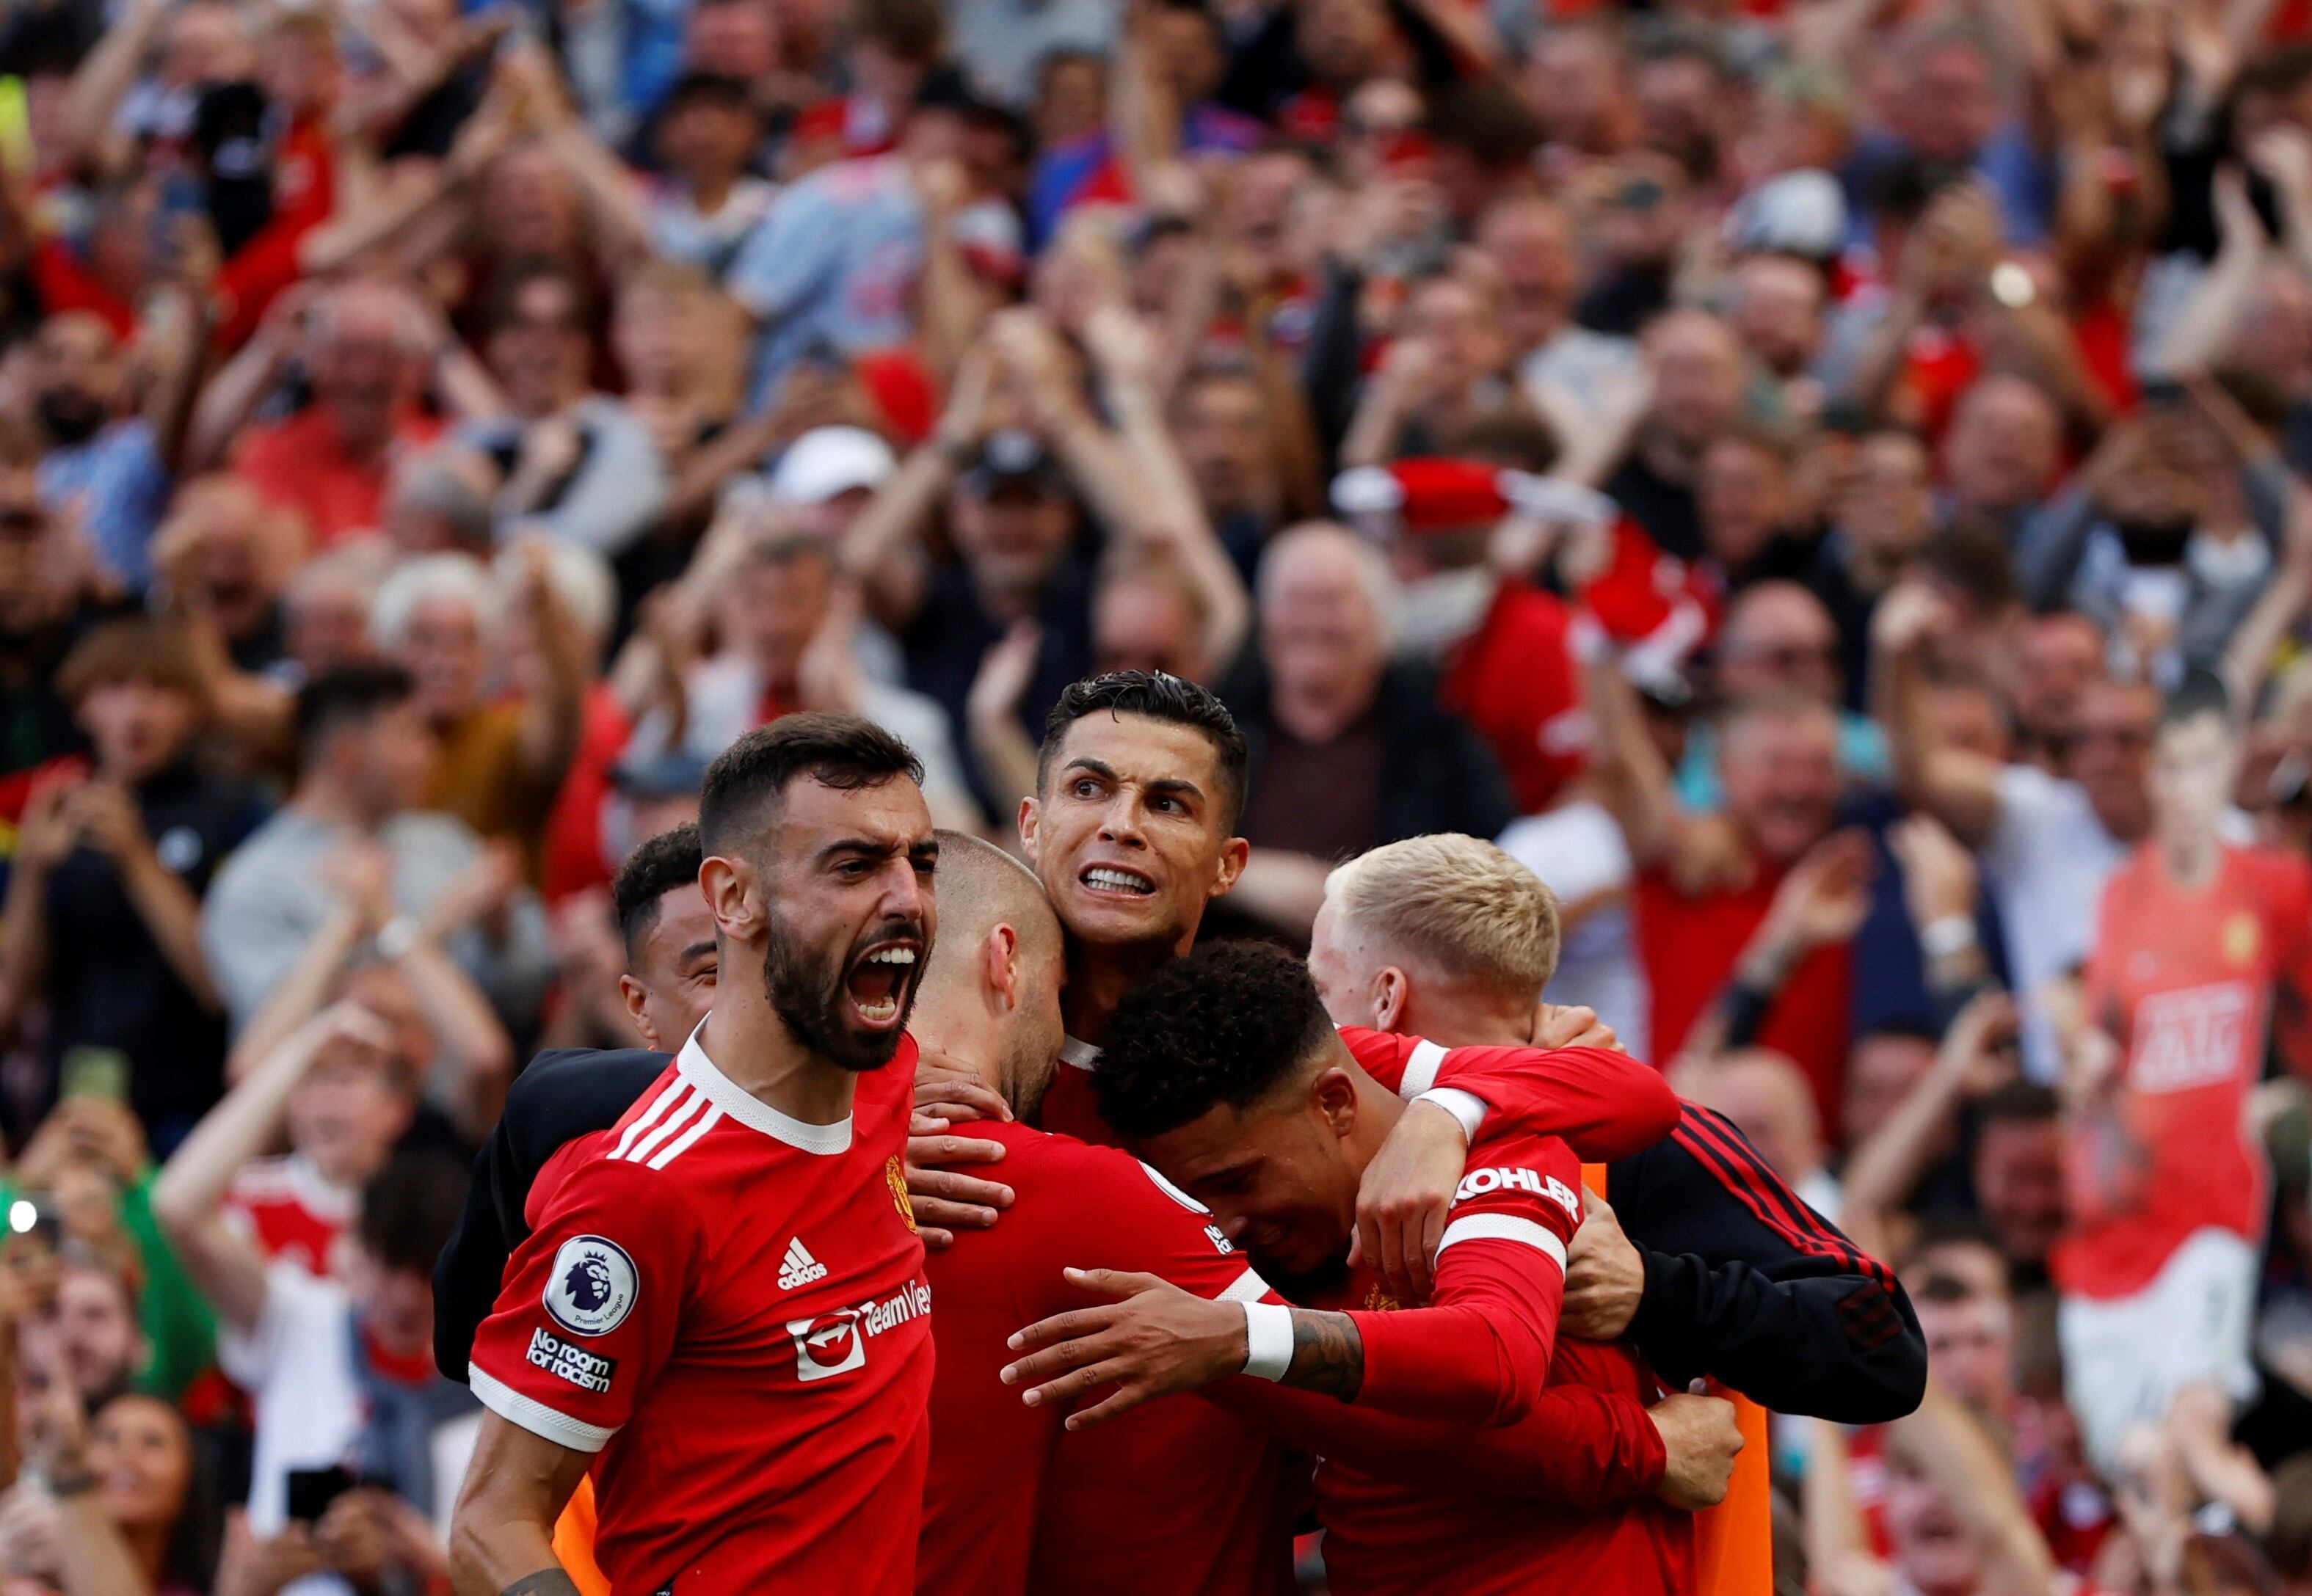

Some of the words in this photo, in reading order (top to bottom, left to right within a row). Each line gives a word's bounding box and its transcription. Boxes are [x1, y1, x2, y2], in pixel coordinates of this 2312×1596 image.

[777, 1263, 828, 1291] adidas
[575, 1314, 604, 1325] Premier
[603, 1294, 624, 1321] League
[526, 1344, 553, 1368] for
[550, 1358, 611, 1393] racism
[531, 1327, 559, 1352] No
[558, 1343, 609, 1376] room
